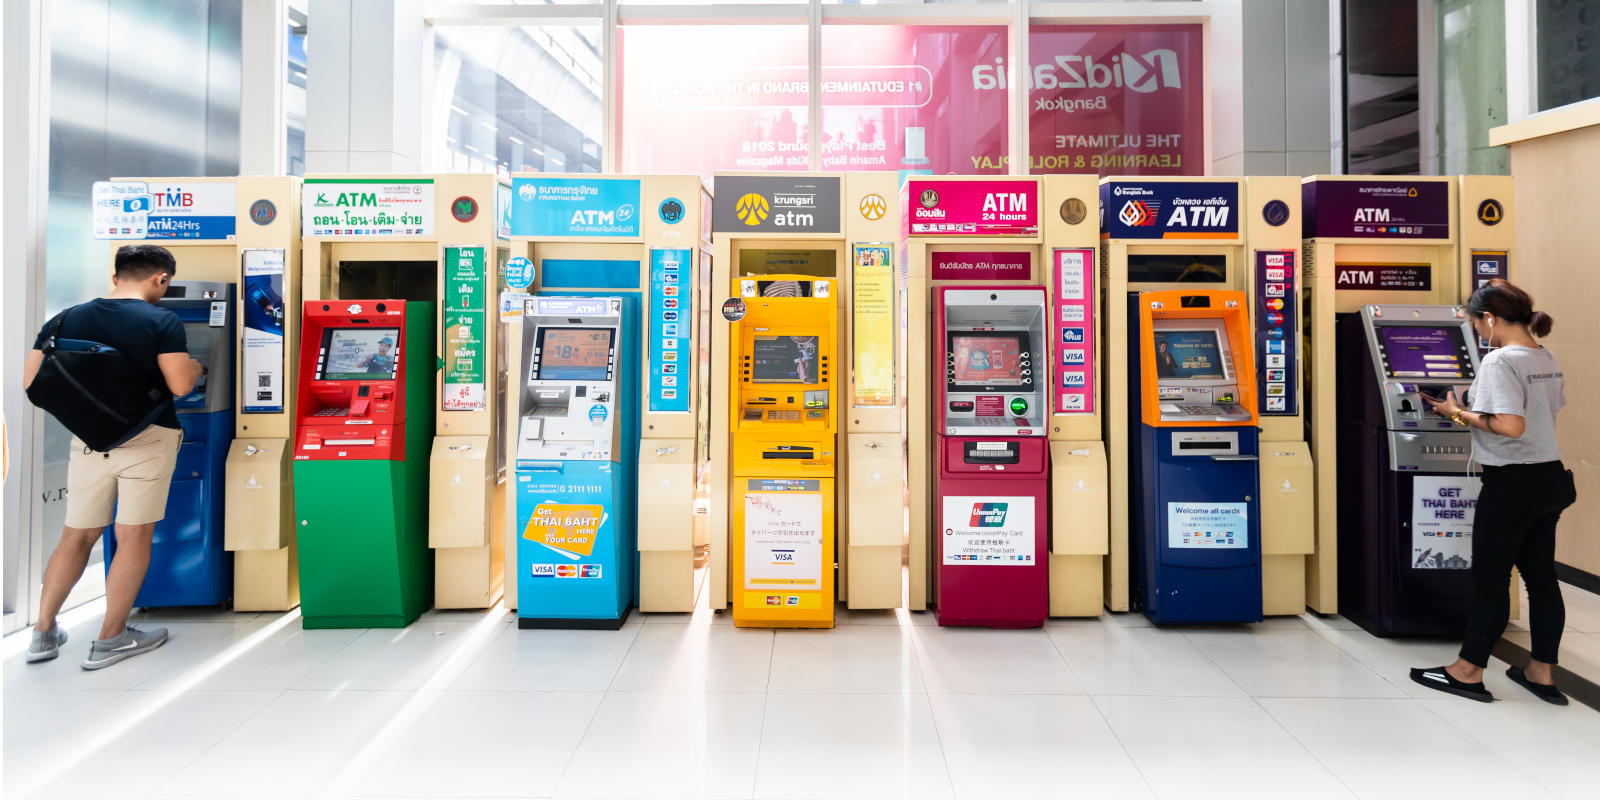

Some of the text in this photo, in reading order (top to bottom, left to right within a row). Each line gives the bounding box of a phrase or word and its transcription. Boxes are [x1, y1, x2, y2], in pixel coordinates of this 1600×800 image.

[154, 187, 193, 207] TMB
[336, 192, 377, 207] ATM
[774, 195, 814, 206] krungsri
[97, 199, 121, 208] HERE
[982, 193, 1027, 212] ATM
[252, 209, 272, 218] TMB
[570, 210, 614, 225] ATM
[983, 212, 1027, 221] 24 hours
[1166, 206, 1230, 227] ATM
[1354, 208, 1390, 222] ATM
[774, 211, 814, 226] atm
[975, 262, 990, 270] ATM
[1337, 270, 1374, 284] ATM
[560, 485, 602, 493] 0 2111 1111
[1438, 487, 1462, 497] GET
[1422, 499, 1478, 508] THAI BAHT
[973, 508, 1006, 519] UnionPay
[1435, 510, 1465, 519] HERE
[533, 517, 598, 526] THAI BAHT
[982, 530, 1008, 538] UnionPay
[774, 553, 793, 561] VISA
[535, 565, 553, 573] VISA
